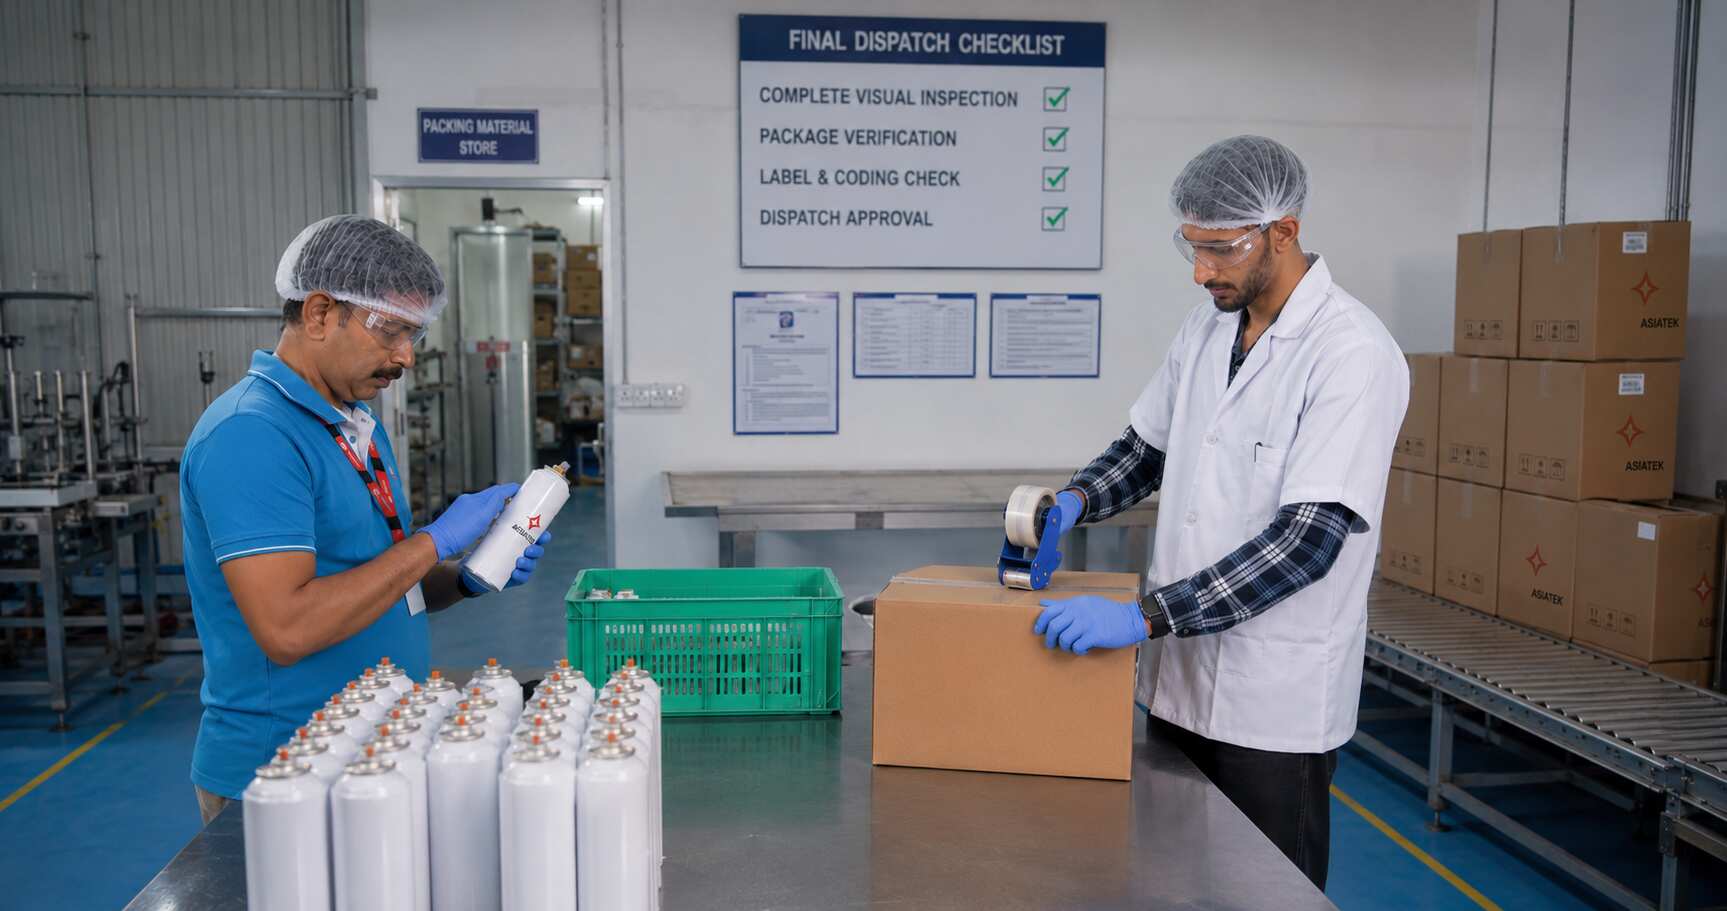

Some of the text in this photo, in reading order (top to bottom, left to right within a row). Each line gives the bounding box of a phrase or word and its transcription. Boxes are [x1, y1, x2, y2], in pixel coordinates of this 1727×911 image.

[789, 30, 1065, 55] FINAL DISPATCH CHECKLIST
[760, 87, 1018, 107] COMPLETE VISUAL INSPECTION
[423, 118, 533, 134] PACKING MATERIAL
[760, 128, 957, 146] PACKAGE VERIFICATION
[459, 140, 498, 155] STORE
[760, 169, 960, 186] LABEL & CODING CHECK
[760, 210, 932, 226] DISPATCH APPROVAL
[1641, 318, 1679, 328] ASIATEK
[1625, 461, 1664, 471] ASIATEK
[1531, 589, 1563, 606] ASIATEK
